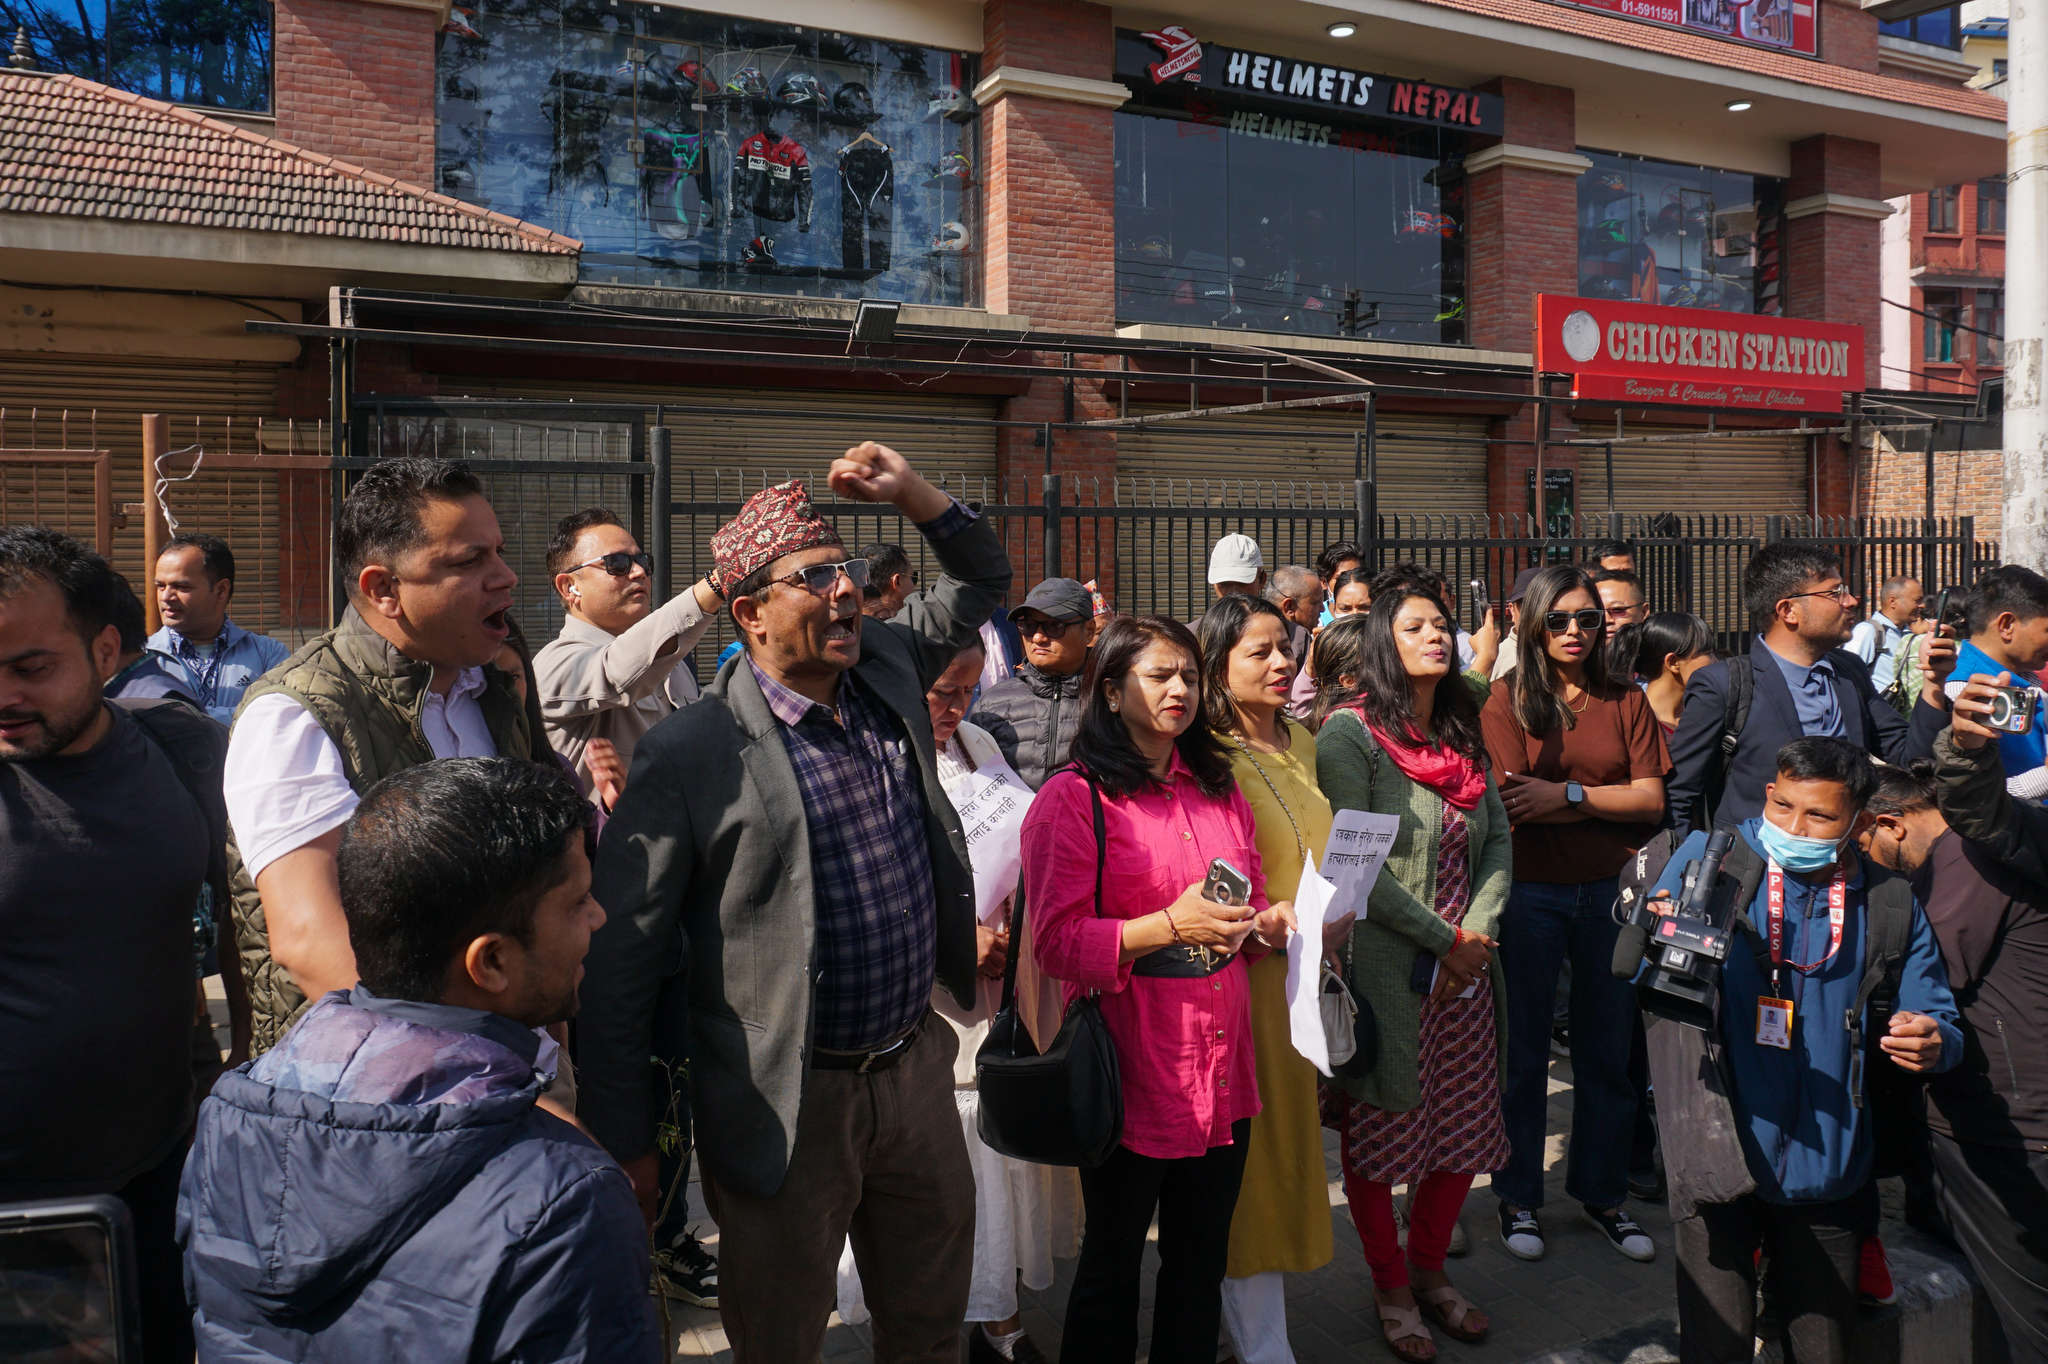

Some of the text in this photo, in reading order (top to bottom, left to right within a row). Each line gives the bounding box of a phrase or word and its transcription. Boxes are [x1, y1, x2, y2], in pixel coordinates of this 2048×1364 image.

[1621, 0, 1679, 22] 01-5911551
[1228, 51, 1483, 126] HELMETS NEPAL
[1229, 110, 1332, 148] HELMETS
[1607, 321, 1850, 377] CHICKEN STATION
[1624, 379, 1806, 406] Burger & Crunchy Fried Chicken
[1770, 874, 1781, 951] PRESS
